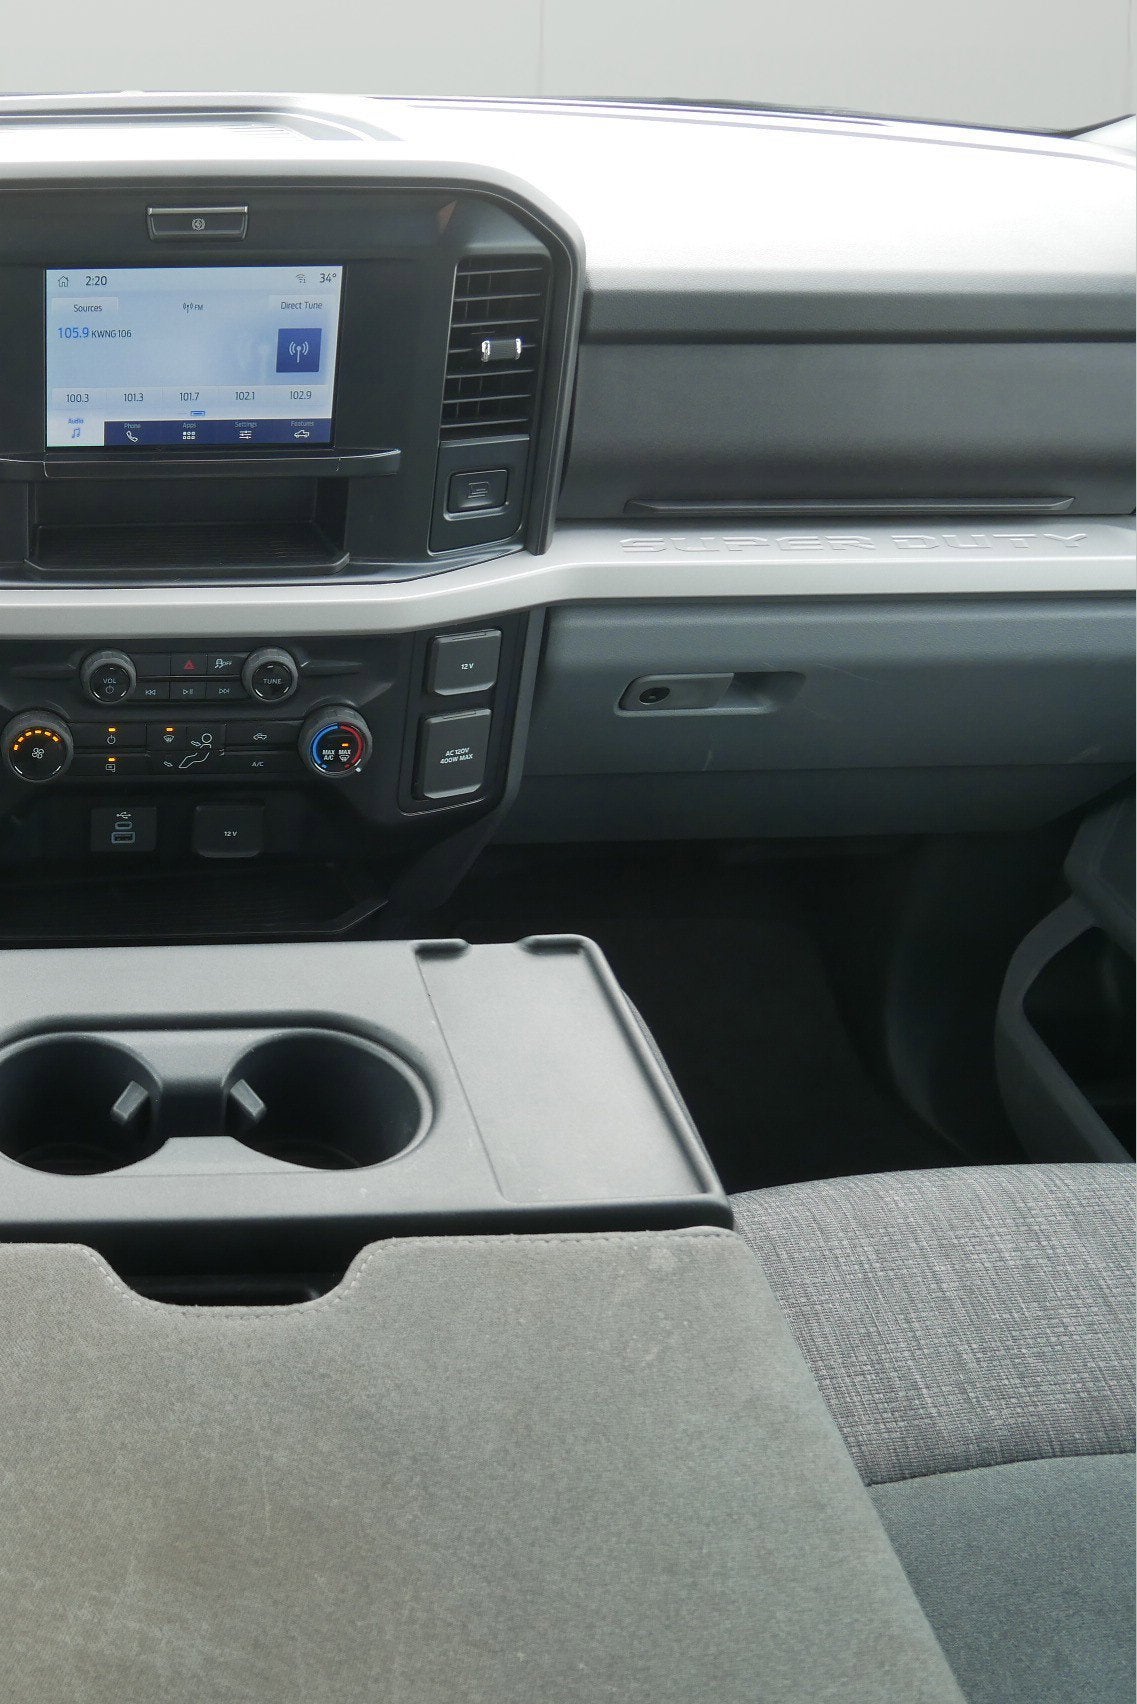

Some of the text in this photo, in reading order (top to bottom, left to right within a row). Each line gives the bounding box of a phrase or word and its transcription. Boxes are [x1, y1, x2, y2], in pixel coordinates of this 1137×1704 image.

[85, 275, 108, 286] 2:20
[73, 304, 103, 313] Sources
[280, 301, 323, 310] Direct Tune
[57, 327, 132, 339] 105.9 KWNG 106
[66, 393, 89, 403] 100.3
[123, 393, 144, 402] 101.3
[179, 392, 200, 402] 101.7
[235, 391, 255, 401] 102.1
[290, 390, 312, 400] 102.9
[619, 533, 1088, 553] SUPER DUTY
[102, 677, 117, 685] VOL
[459, 753, 473, 761] MAX
